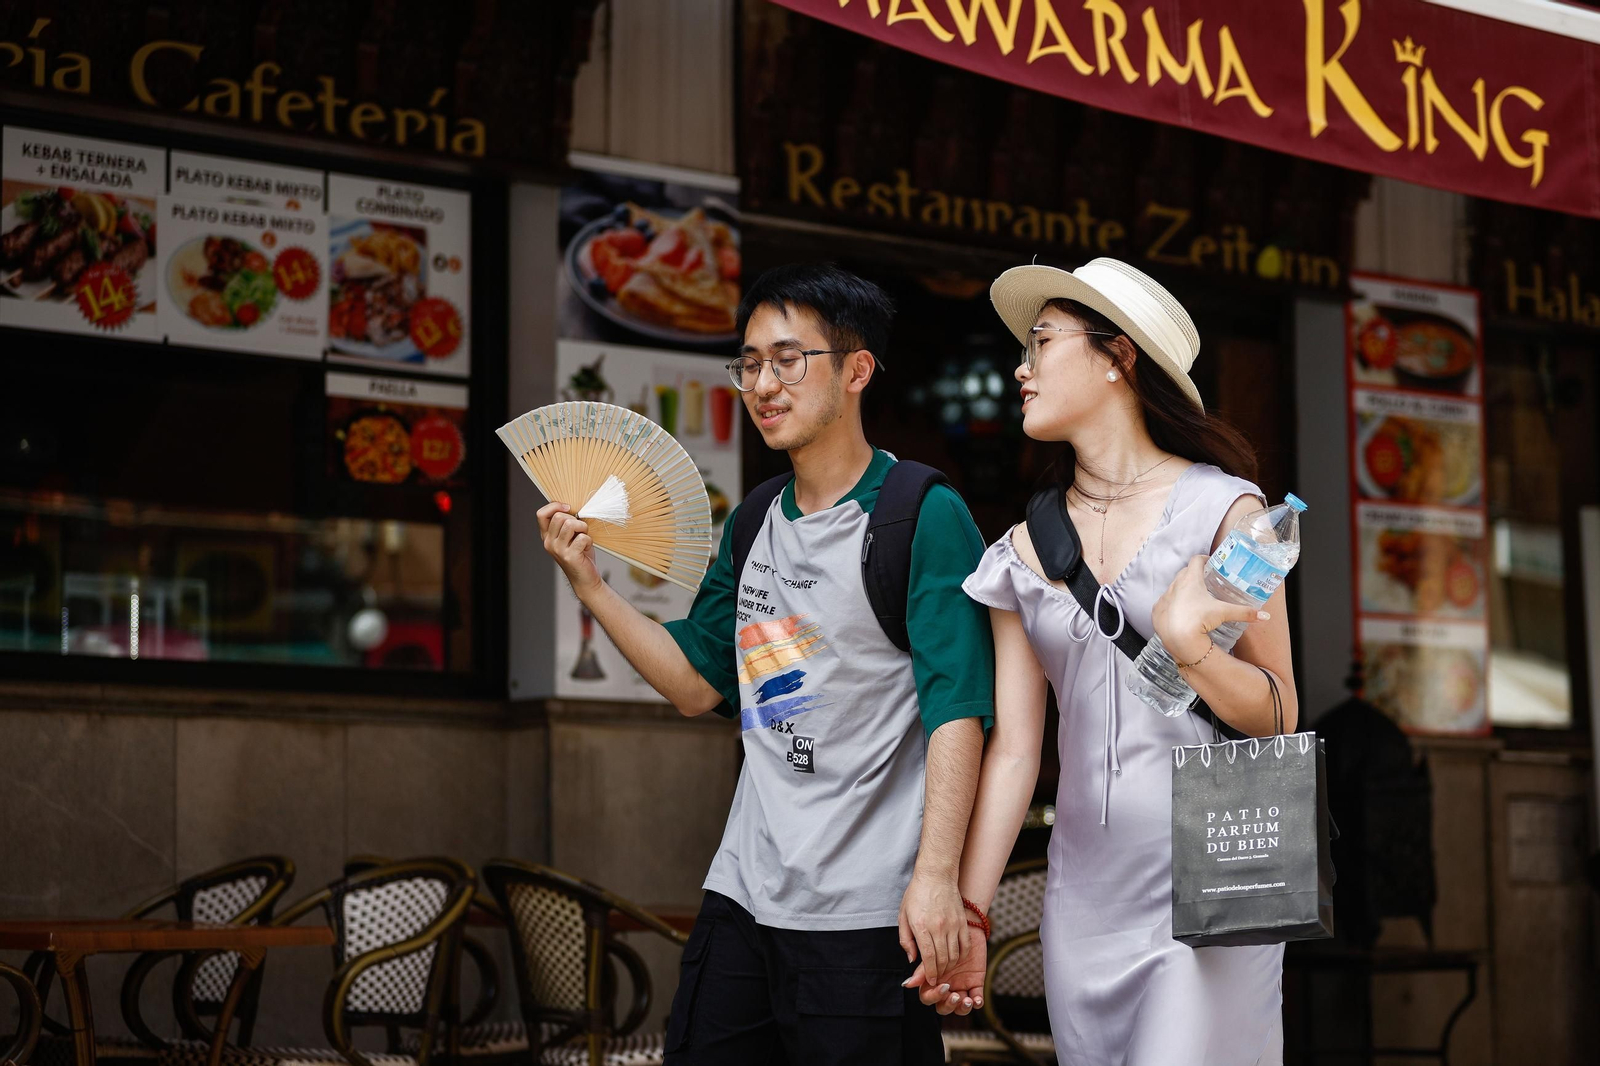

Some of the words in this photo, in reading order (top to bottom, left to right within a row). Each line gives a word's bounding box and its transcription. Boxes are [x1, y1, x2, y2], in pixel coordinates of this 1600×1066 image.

[838, 0, 1274, 118] AWARMA
[130, 39, 488, 158] Cafetería
[22, 142, 73, 162] KEBAB
[77, 150, 147, 174] TERNERA
[50, 164, 133, 188] ENSALADA
[176, 167, 224, 189] PLATO
[226, 174, 272, 193] KEBAB
[275, 181, 322, 201] MIXTO
[377, 185, 424, 205] PLATO
[783, 140, 1127, 250] Restaurante
[171, 204, 219, 224] PLATO
[222, 213, 267, 230] KEBAB
[270, 217, 316, 236] MIXTO
[356, 199, 445, 223] COMBINADO
[369, 382, 418, 397] PAELLA
[796, 738, 814, 751] ON
[787, 751, 809, 765] B528
[1207, 806, 1280, 823] PATIO
[1207, 822, 1279, 838] PARFUM
[1207, 841, 1230, 854] DU
[1238, 837, 1279, 851] BIEN
